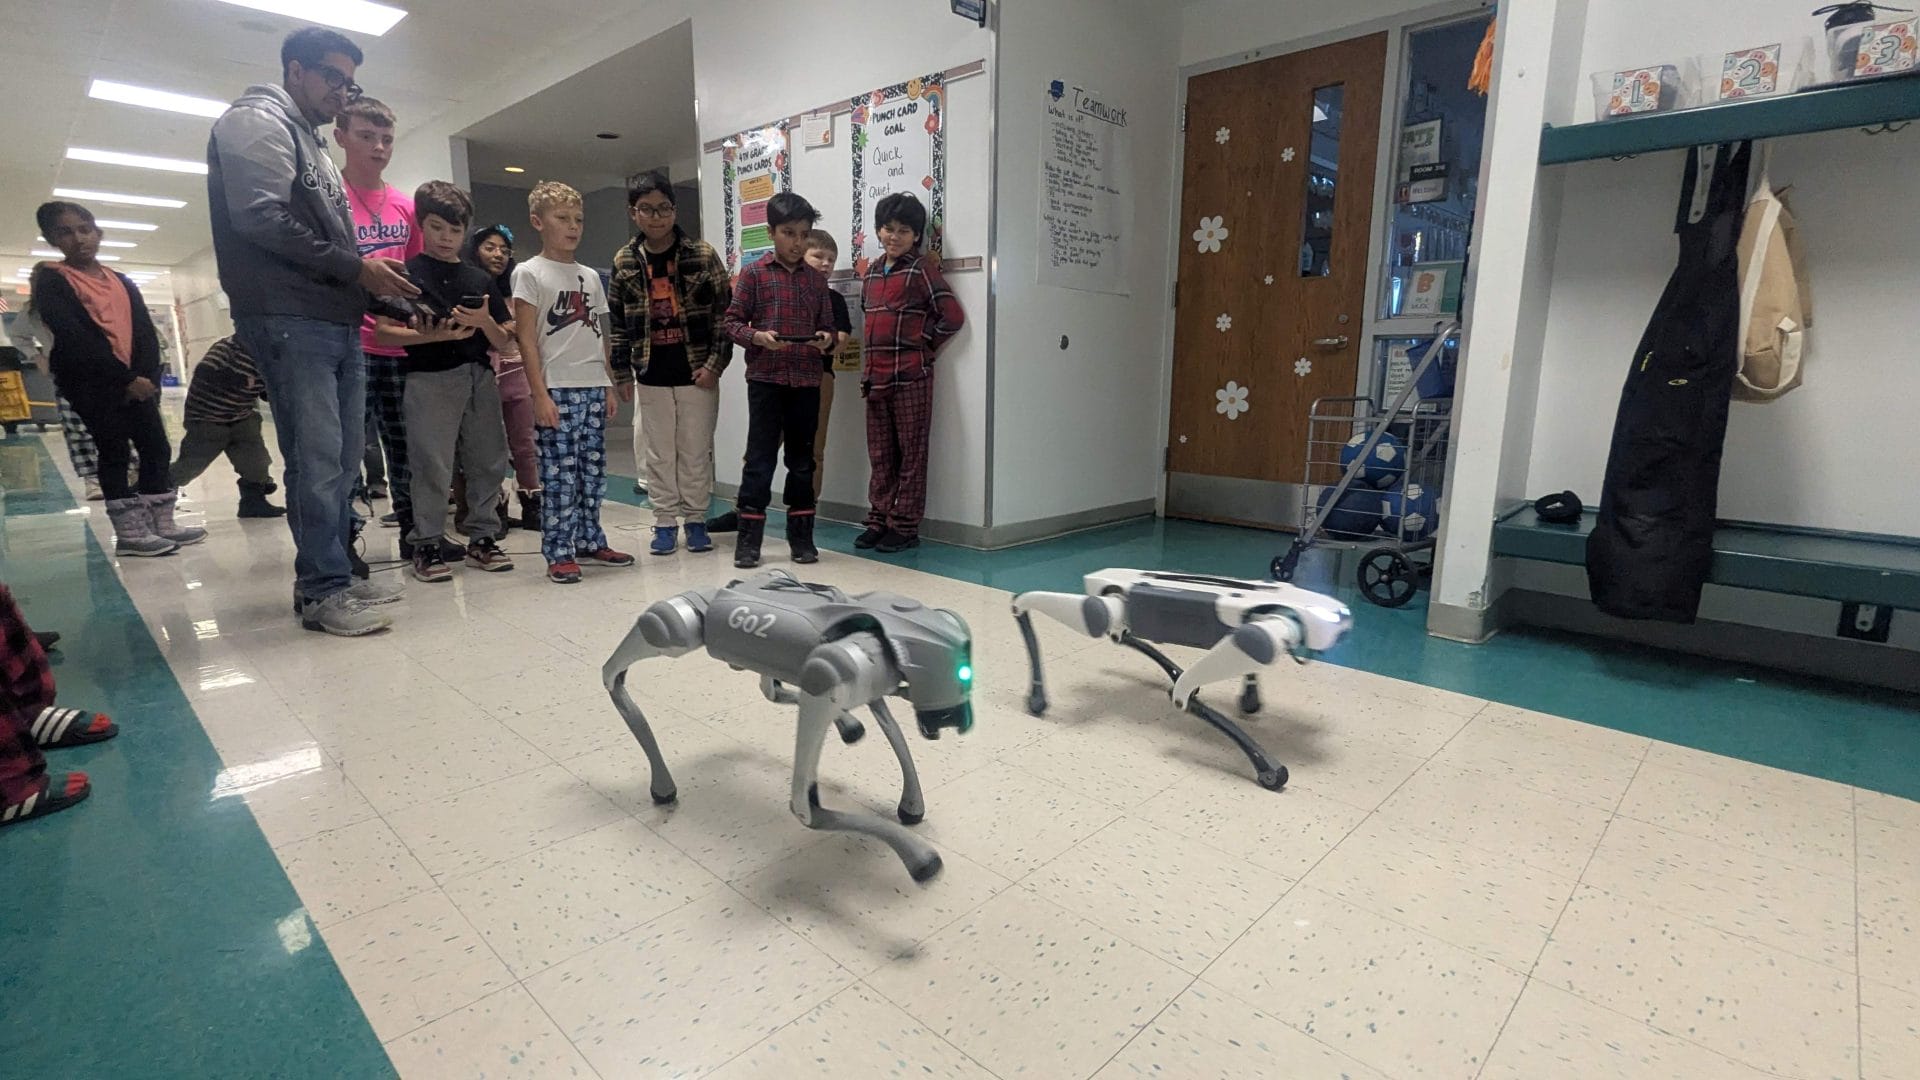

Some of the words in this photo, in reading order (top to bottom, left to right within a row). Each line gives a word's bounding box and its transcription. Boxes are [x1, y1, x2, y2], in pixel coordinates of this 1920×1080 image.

[1875, 35, 1901, 66] 3
[1738, 58, 1762, 88] 2
[1630, 79, 1642, 104] 1
[872, 108, 896, 124] PUNCH
[897, 102, 918, 117] CARD
[1072, 86, 1128, 127] Teamwork
[737, 163, 753, 176] PUNCH
[754, 156, 772, 171] CARDS
[873, 146, 903, 166] Quick
[888, 162, 905, 177] and
[354, 219, 410, 241] ockets
[728, 606, 776, 638] Go2
